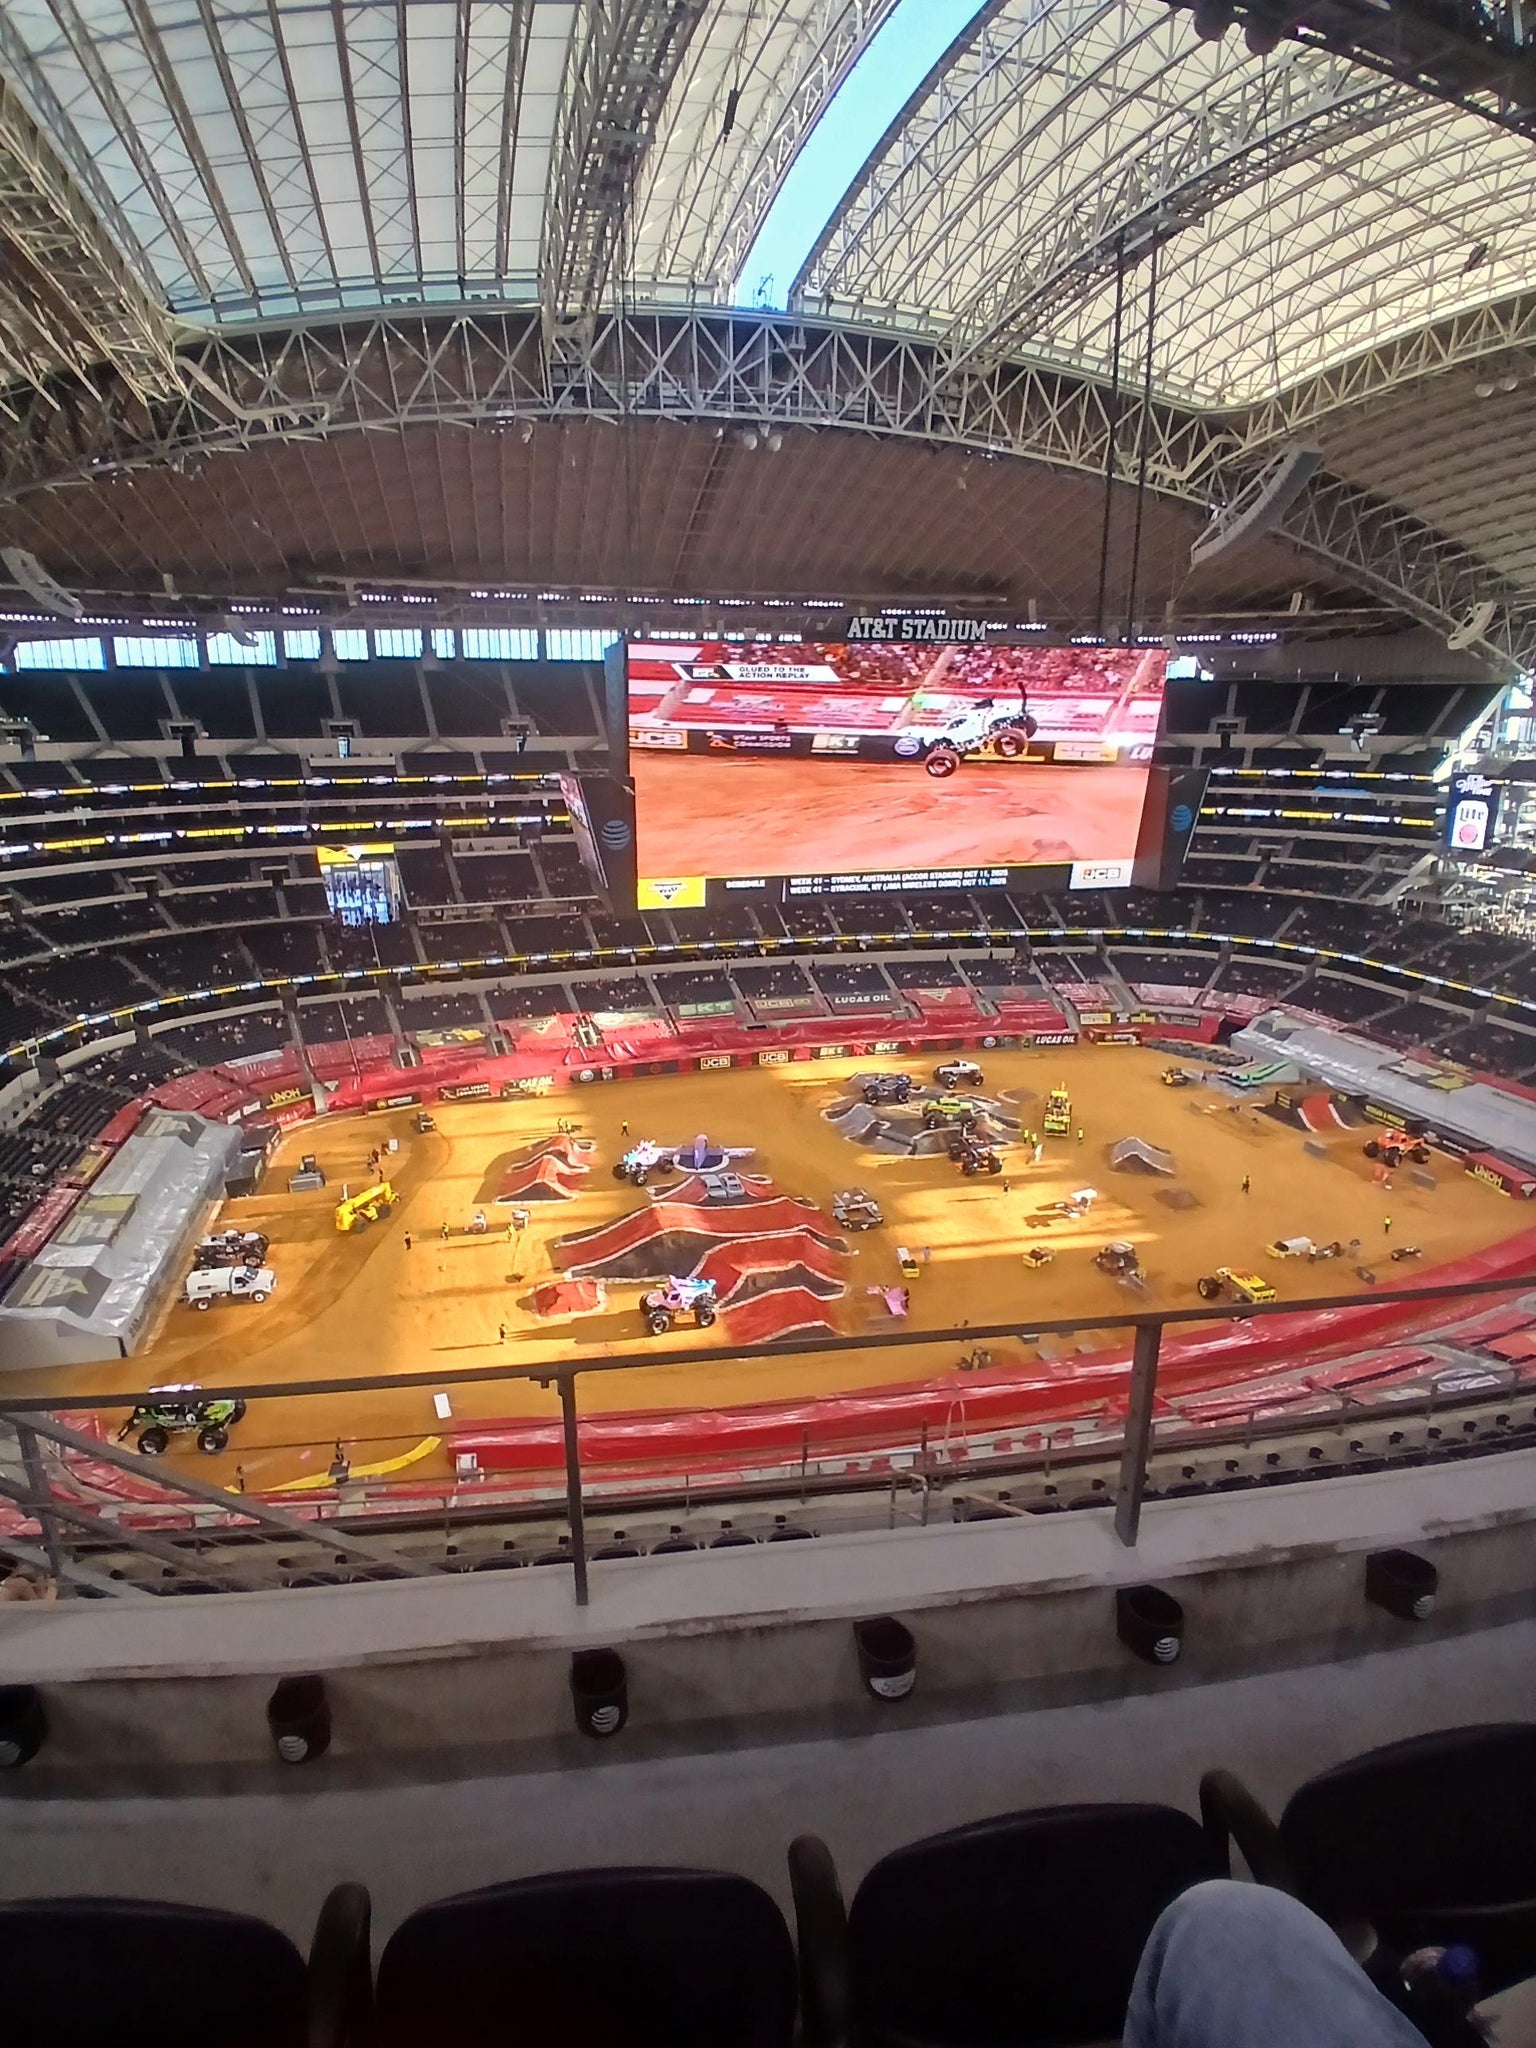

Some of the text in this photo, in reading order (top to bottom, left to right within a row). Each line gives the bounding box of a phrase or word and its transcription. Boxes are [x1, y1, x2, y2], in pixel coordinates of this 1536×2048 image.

[847, 617, 987, 640] AT&T STADIUM
[1083, 867, 1121, 880] JCB
[790, 877, 812, 886] WEEK
[790, 886, 812, 894] WEEK
[835, 994, 891, 1004] LUCAS OIL
[1036, 1035, 1075, 1044] LUCAS OIL
[702, 1056, 729, 1069] JCB
[760, 1051, 787, 1063] JCB
[271, 1088, 301, 1103] UNOH
[1474, 1164, 1503, 1187] UNOH
